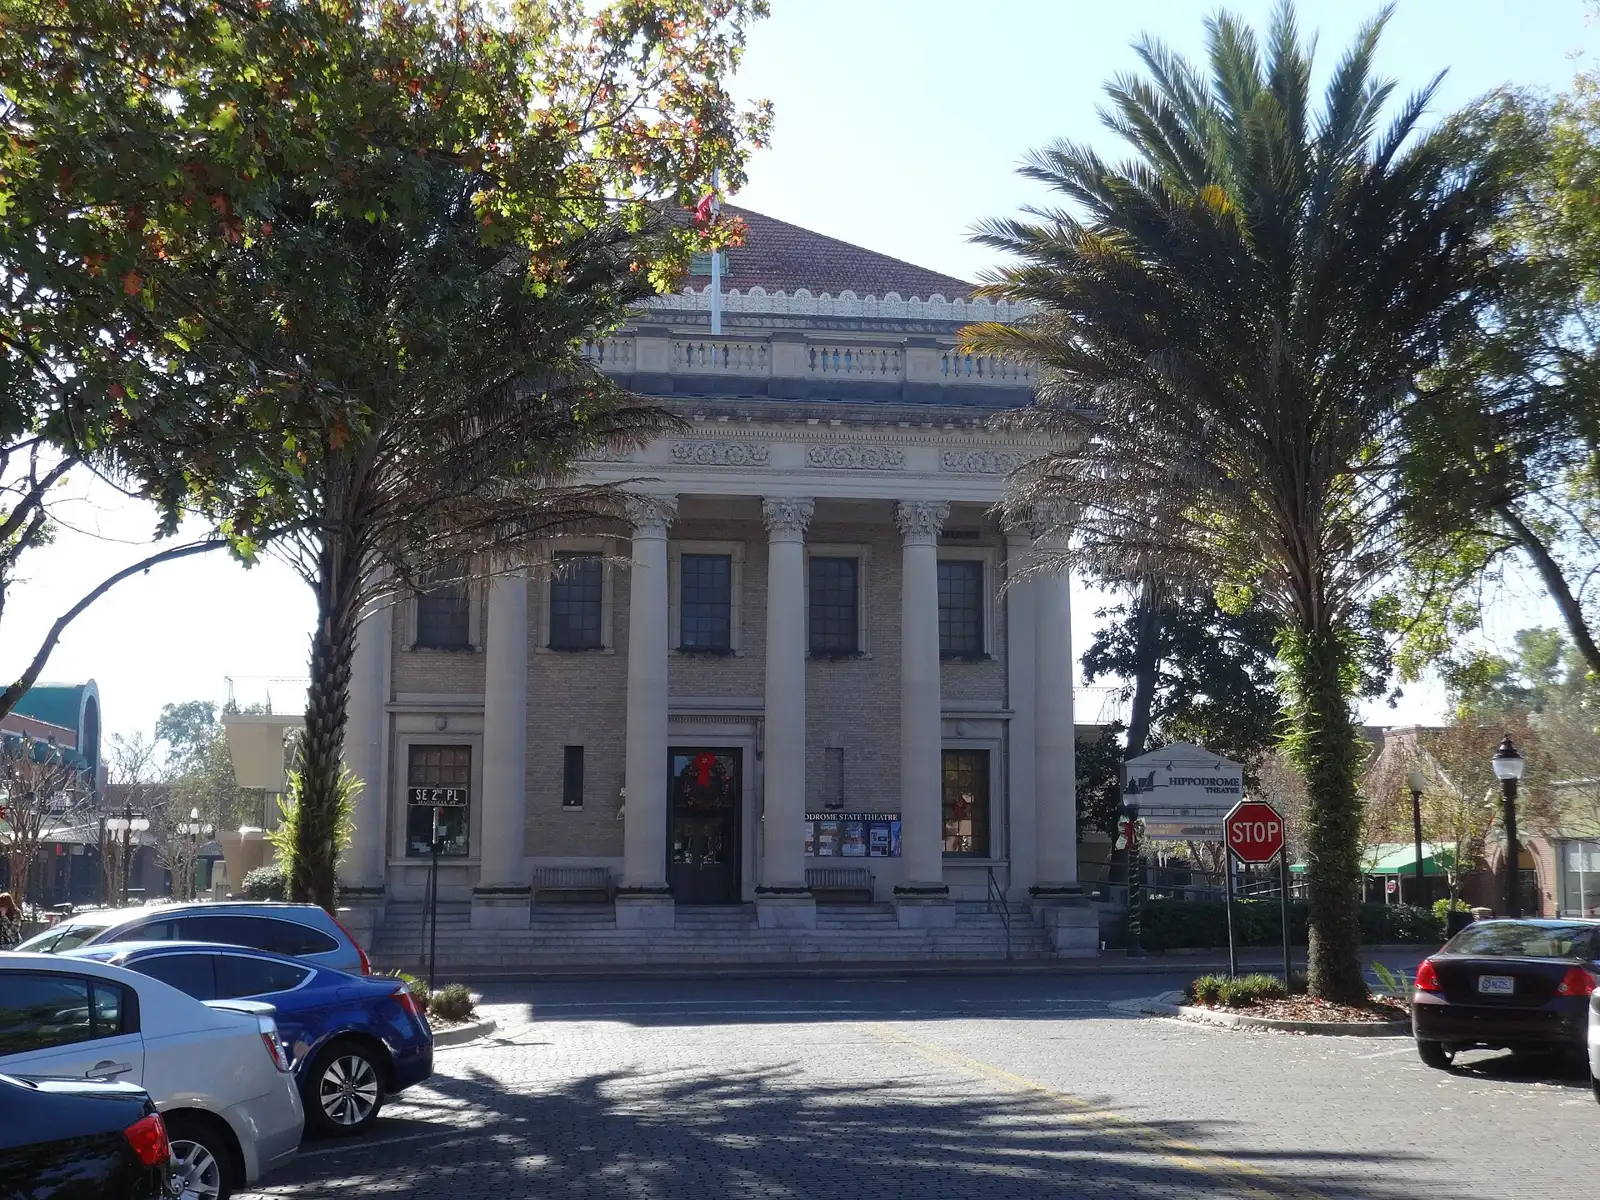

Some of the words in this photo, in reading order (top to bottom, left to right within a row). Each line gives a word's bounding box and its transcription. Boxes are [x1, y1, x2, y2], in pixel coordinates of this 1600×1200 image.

[1169, 777, 1240, 786] HIPPODROME
[415, 790, 427, 801] SE
[447, 790, 459, 801] PL
[838, 813, 862, 821] STATE
[862, 813, 898, 821] THEATRE
[1232, 821, 1279, 843] STOP
